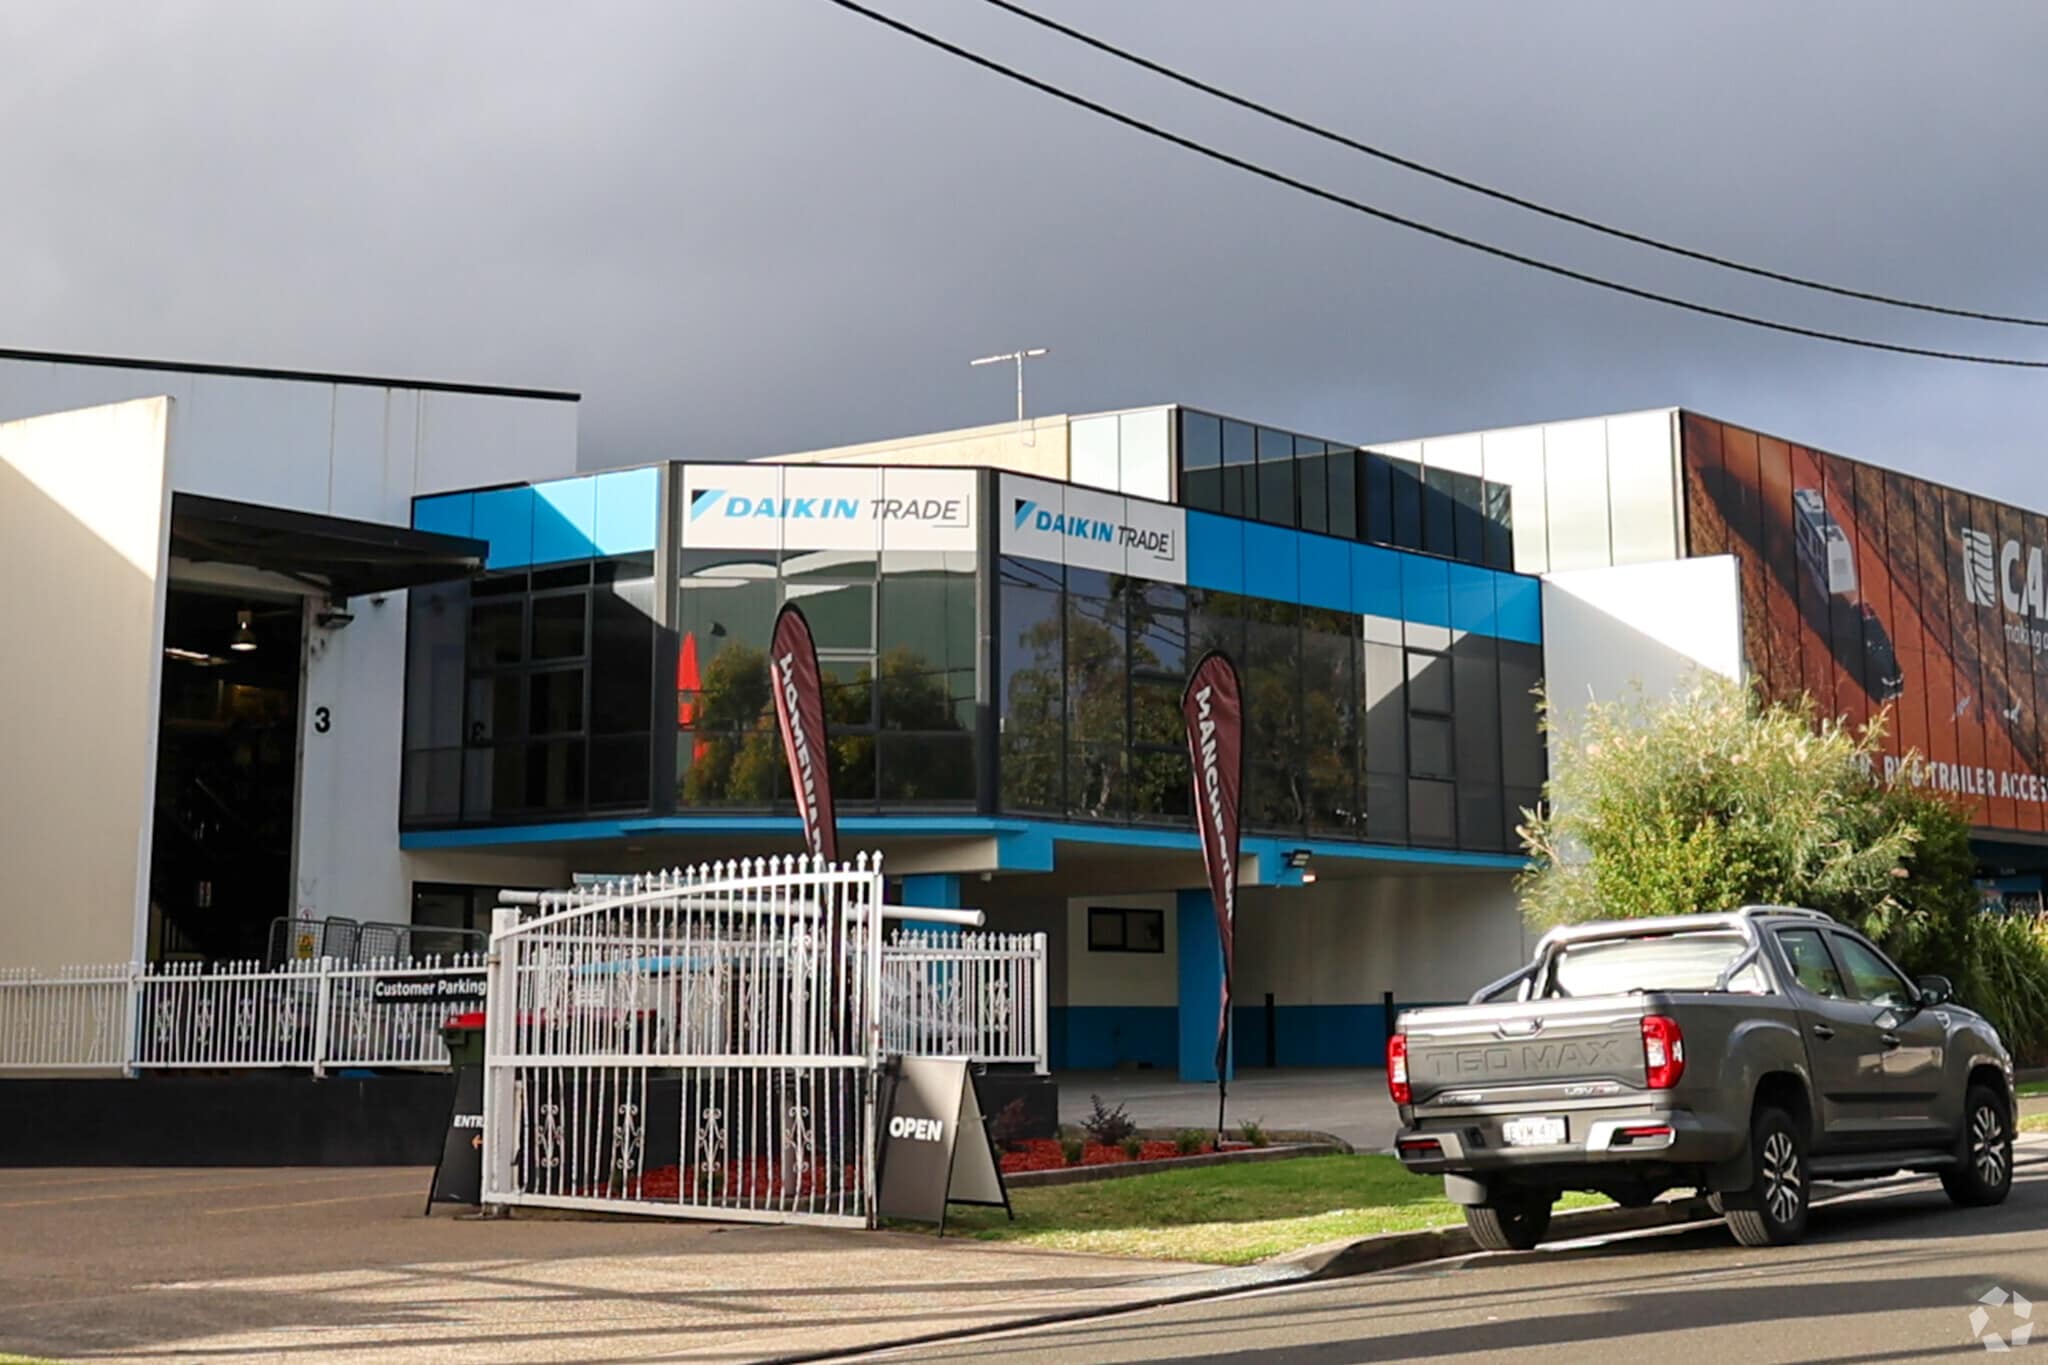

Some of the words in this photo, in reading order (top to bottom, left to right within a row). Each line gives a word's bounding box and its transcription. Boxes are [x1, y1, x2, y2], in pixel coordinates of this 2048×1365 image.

[724, 497, 860, 519] DAIKIN
[871, 499, 960, 520] TRADE
[1036, 510, 1114, 543] DAIKIN
[1117, 525, 1169, 552] TRADE
[2001, 539, 2048, 621] CA
[314, 706, 331, 733] 3
[779, 652, 828, 873] HOMEWAR
[1929, 762, 1996, 797] TRAILER
[2001, 770, 2048, 803] ACCES
[375, 981, 436, 997] Customer
[438, 979, 487, 997] Parking
[1522, 1039, 1621, 1073] MAX
[453, 1115, 485, 1128] ENTR
[889, 1116, 943, 1142] OPEN
